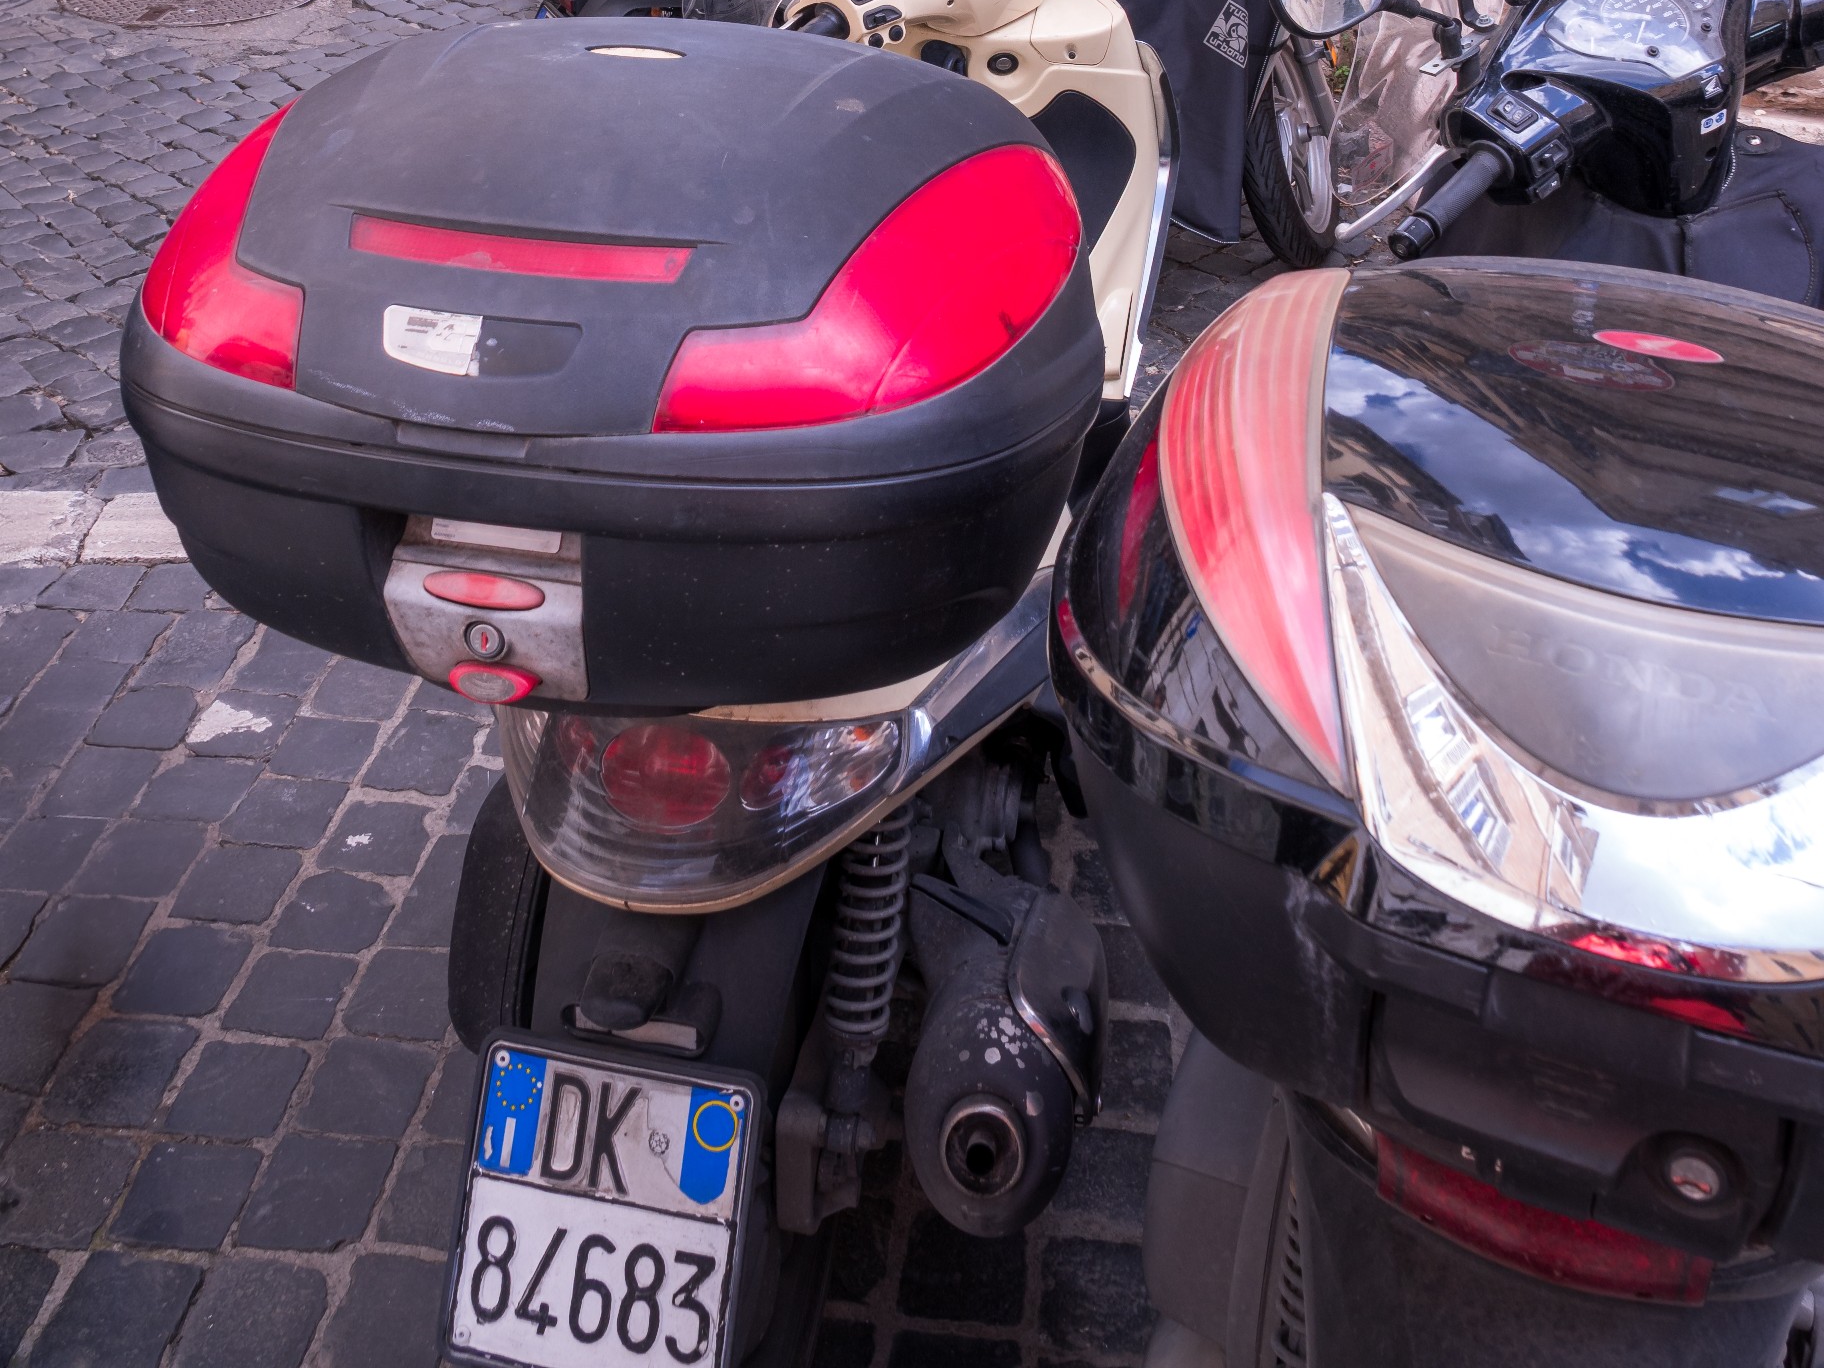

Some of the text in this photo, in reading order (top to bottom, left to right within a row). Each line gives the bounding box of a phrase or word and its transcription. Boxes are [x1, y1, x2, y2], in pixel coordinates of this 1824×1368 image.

[1209, 36, 1246, 63] urbano
[1486, 625, 1777, 721] HONDA
[540, 1071, 630, 1196] DK
[471, 1215, 716, 1364] 84683
